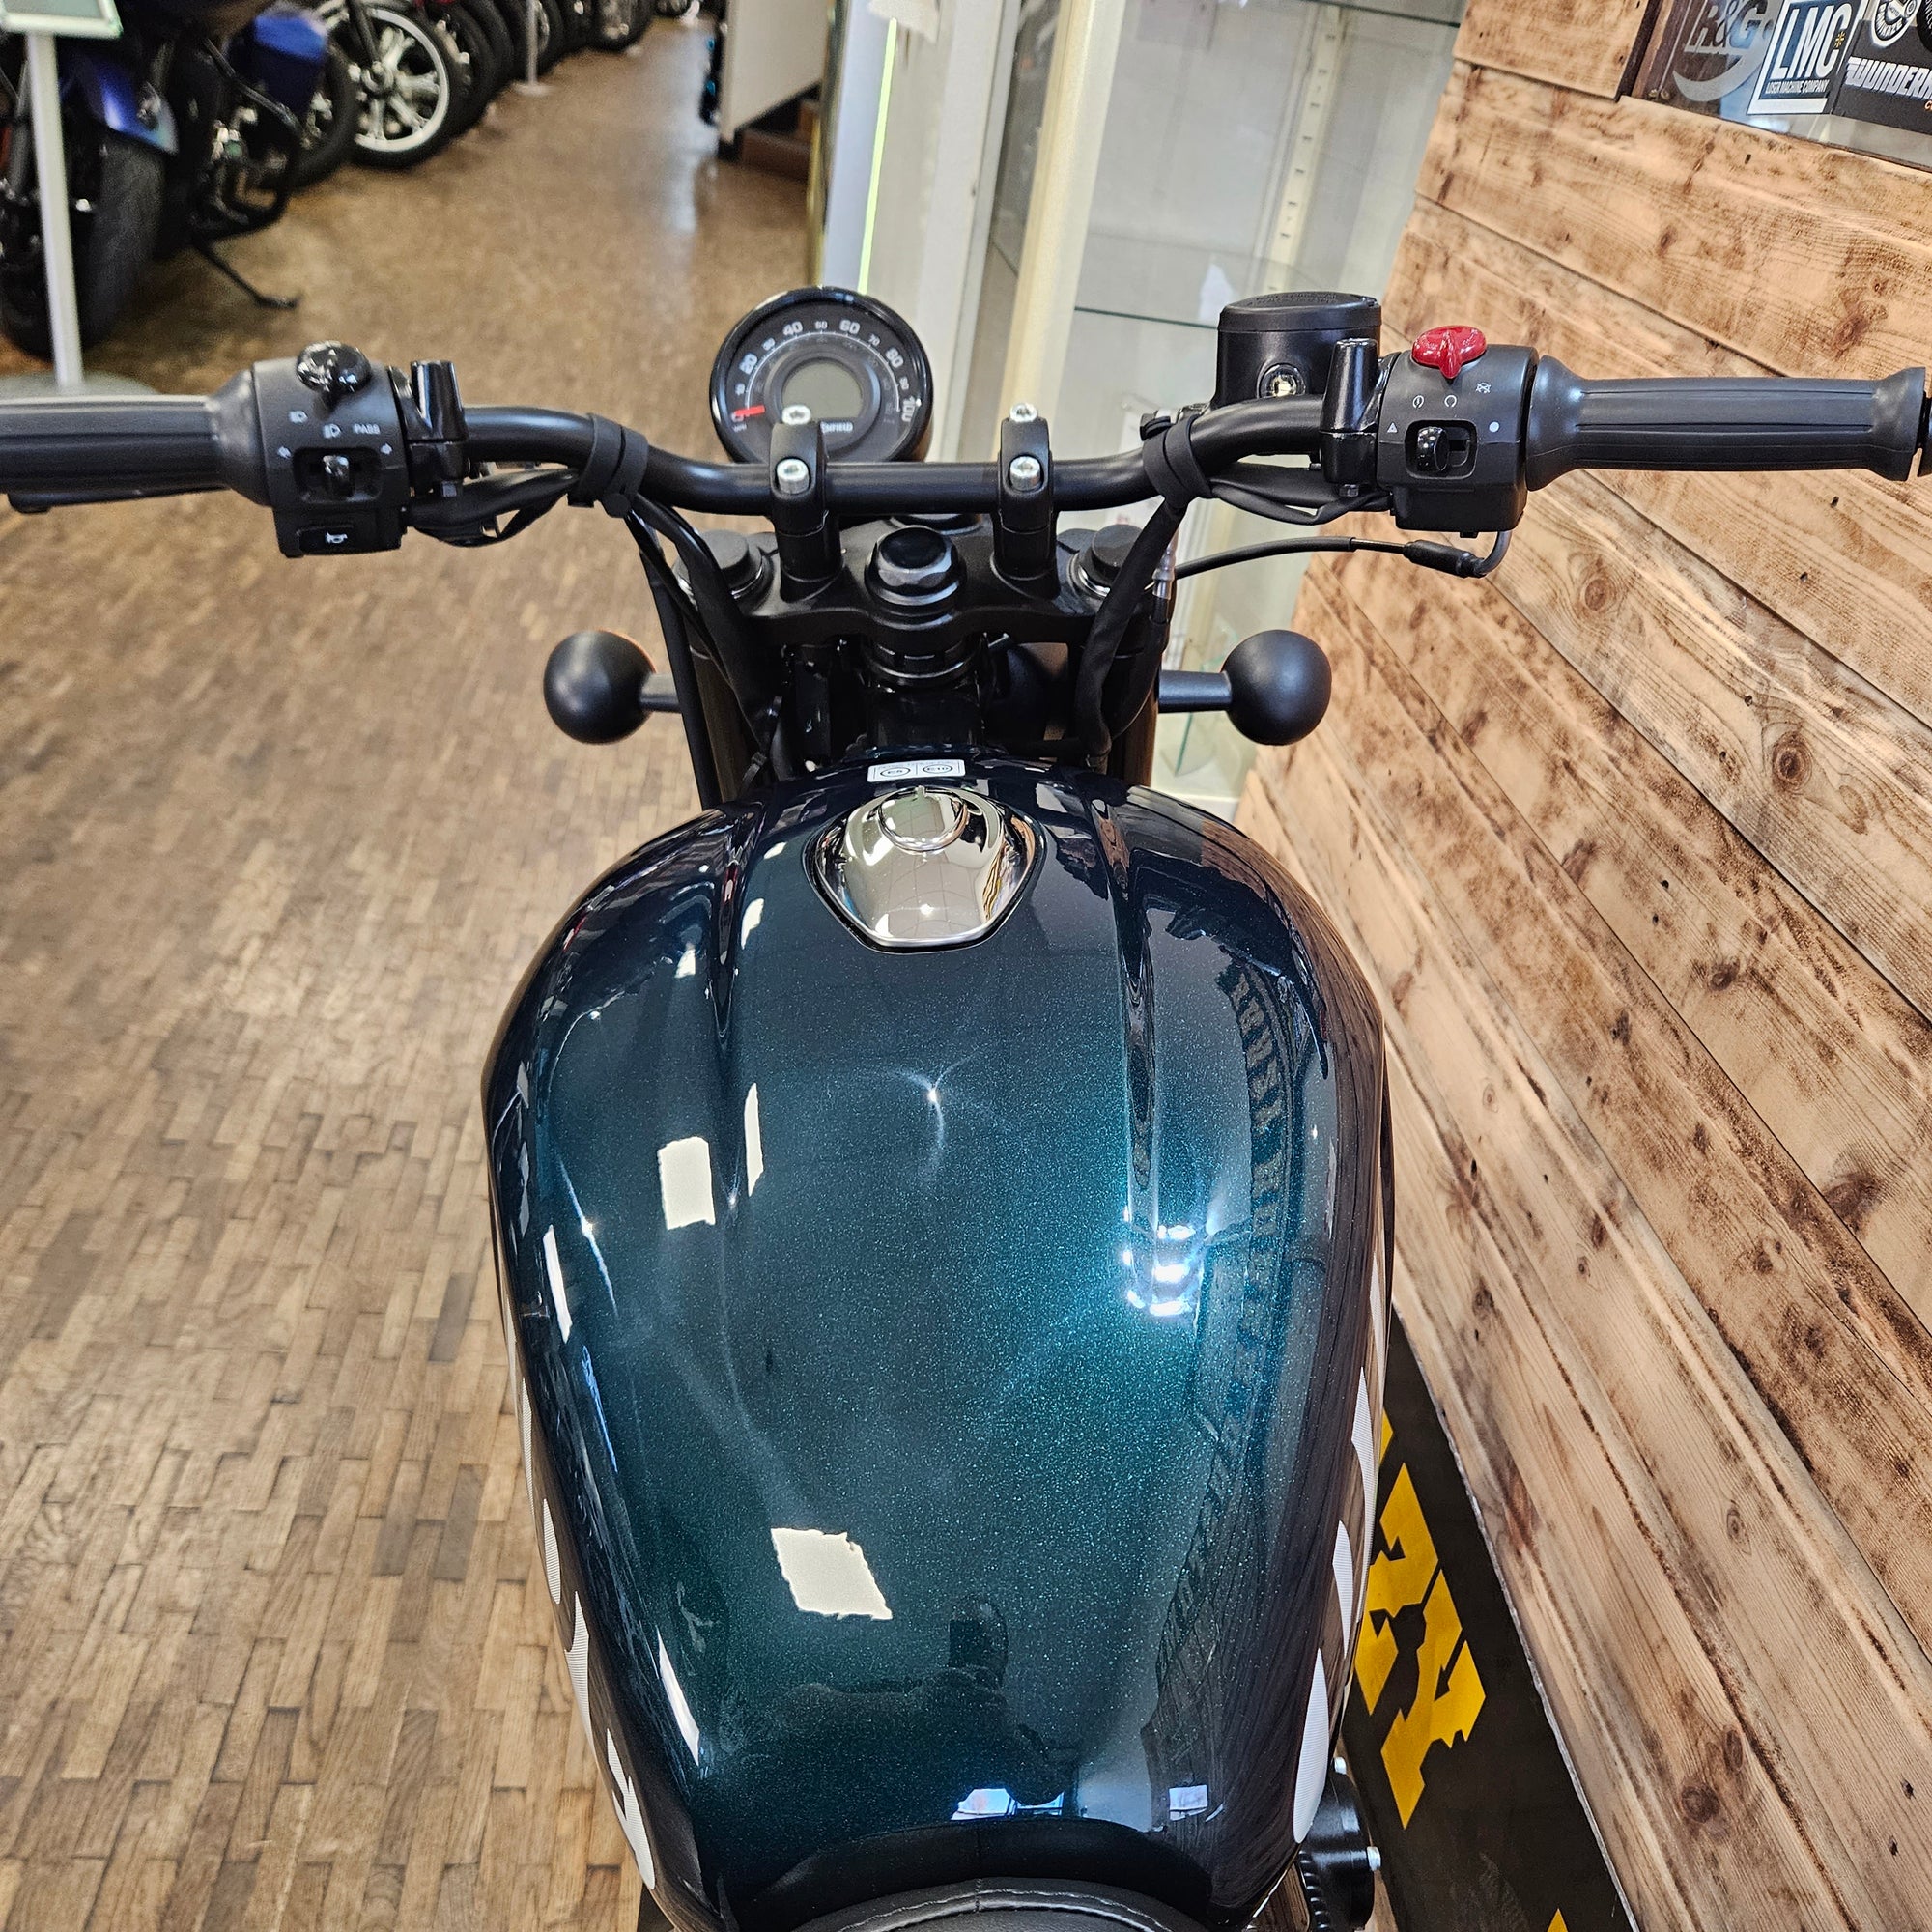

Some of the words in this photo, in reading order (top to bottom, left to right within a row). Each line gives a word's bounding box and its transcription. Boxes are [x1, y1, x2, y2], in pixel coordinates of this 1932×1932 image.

[1770, 3, 1852, 79] LMC
[1803, 79, 1831, 93] COMPANY
[782, 321, 803, 336] 40
[838, 319, 861, 334] 60
[869, 333, 881, 347] 70
[738, 353, 758, 375] 20
[885, 348, 904, 368] 80
[899, 376, 910, 390] 90
[900, 396, 916, 422] 100
[353, 423, 381, 435] PASS
